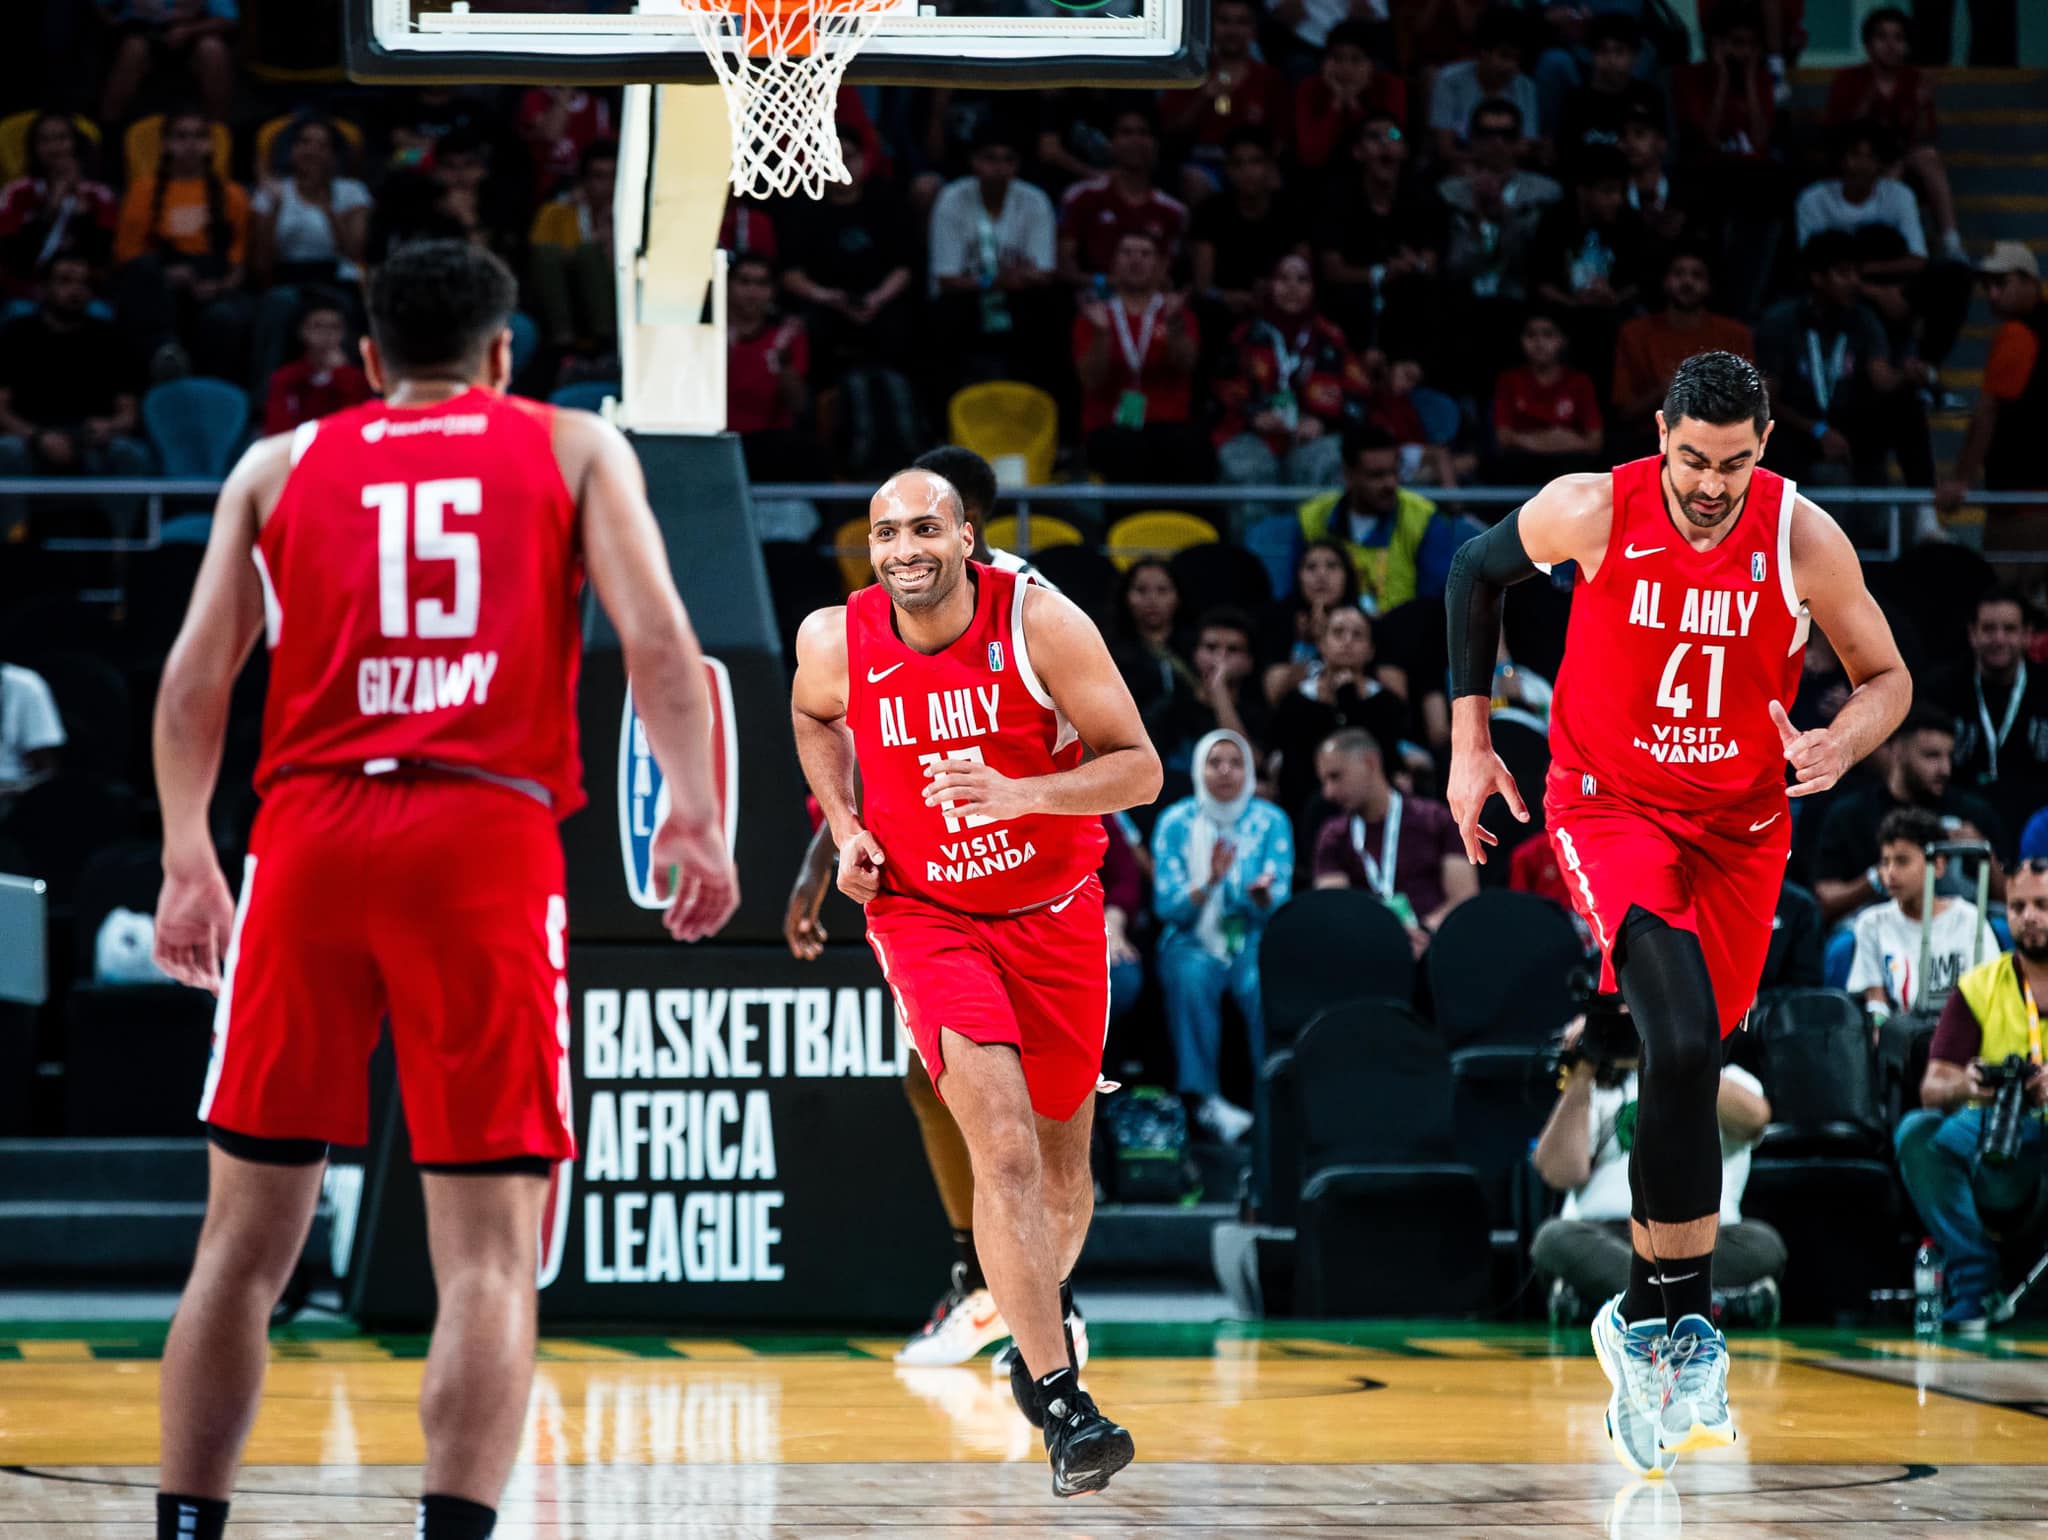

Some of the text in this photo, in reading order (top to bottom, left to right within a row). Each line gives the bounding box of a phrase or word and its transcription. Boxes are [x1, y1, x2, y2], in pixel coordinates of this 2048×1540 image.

[361, 477, 482, 639] 15
[1628, 579, 1760, 637] AL AHLY
[357, 651, 498, 716] GIZAWY
[1656, 642, 1726, 719] 41
[878, 683, 1001, 748] AL AHLY
[1652, 724, 1723, 745] VISIT
[926, 841, 1037, 883] RWANDA
[939, 829, 1009, 862] VISIT
[584, 1090, 777, 1181] AFRICA
[584, 1191, 785, 1283] LEAGUE
